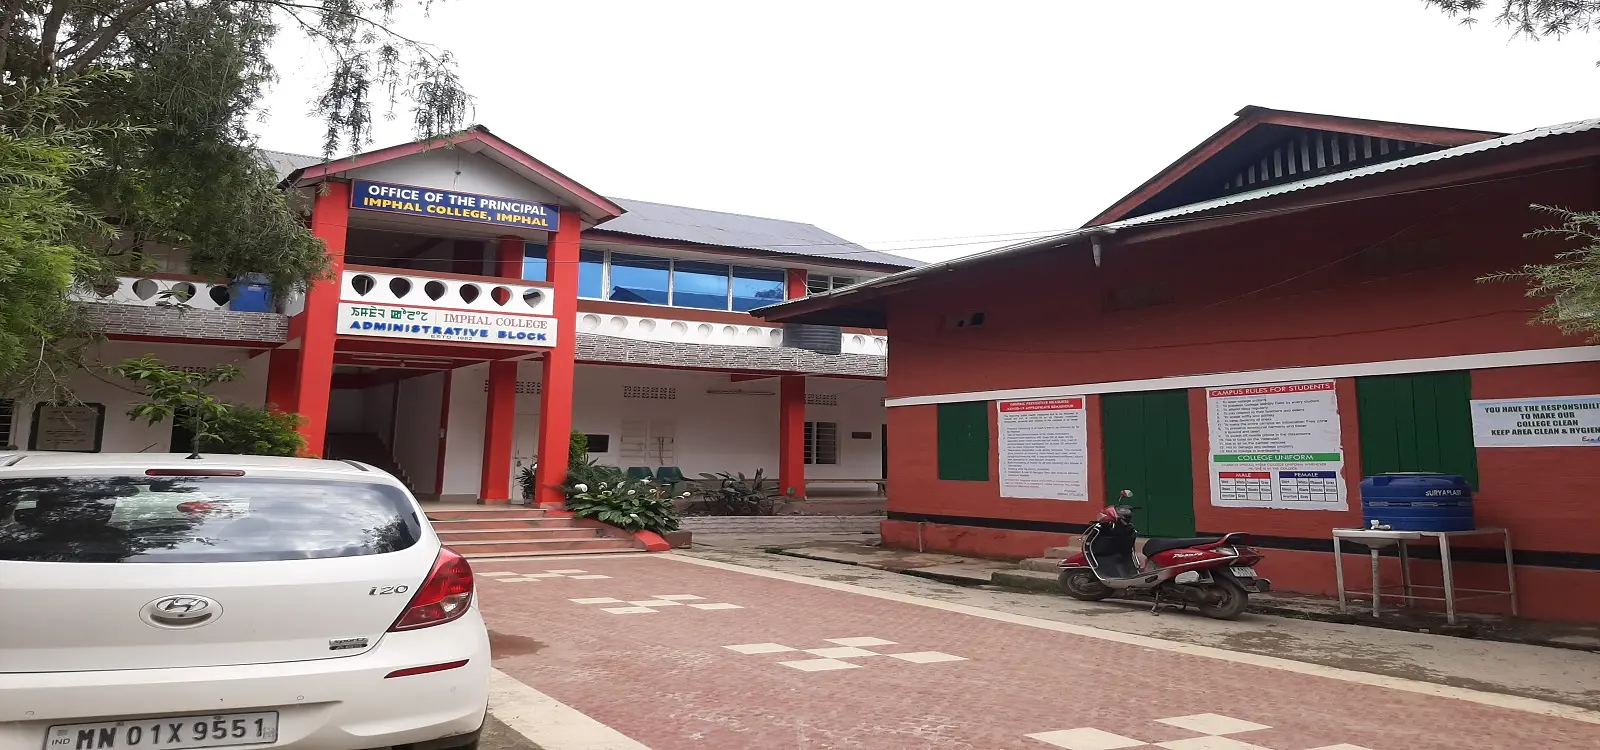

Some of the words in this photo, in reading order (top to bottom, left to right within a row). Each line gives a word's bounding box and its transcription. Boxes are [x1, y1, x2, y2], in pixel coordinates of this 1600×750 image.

[368, 185, 420, 200] OFFICE
[424, 192, 444, 203] OF
[448, 194, 476, 207] THE
[480, 198, 547, 216] PRINCIPAL
[363, 197, 423, 212] IMPHAL
[426, 204, 492, 221] COLLEGE,
[496, 213, 549, 227] IMPHAL
[350, 320, 489, 338] ADMINISTRATIVE
[497, 330, 547, 341] BLOCK
[444, 313, 492, 326] IMPHAL
[495, 317, 548, 330] COLLEGE
[1211, 387, 1243, 397] CAMPUS
[1245, 386, 1268, 394] RULES
[1269, 384, 1286, 393] FOR
[1288, 383, 1331, 392] STUDENTS
[1274, 453, 1314, 461] UNIFORM
[51, 738, 71, 746] IND
[76, 727, 117, 750] MN
[192, 718, 264, 741] 9551
